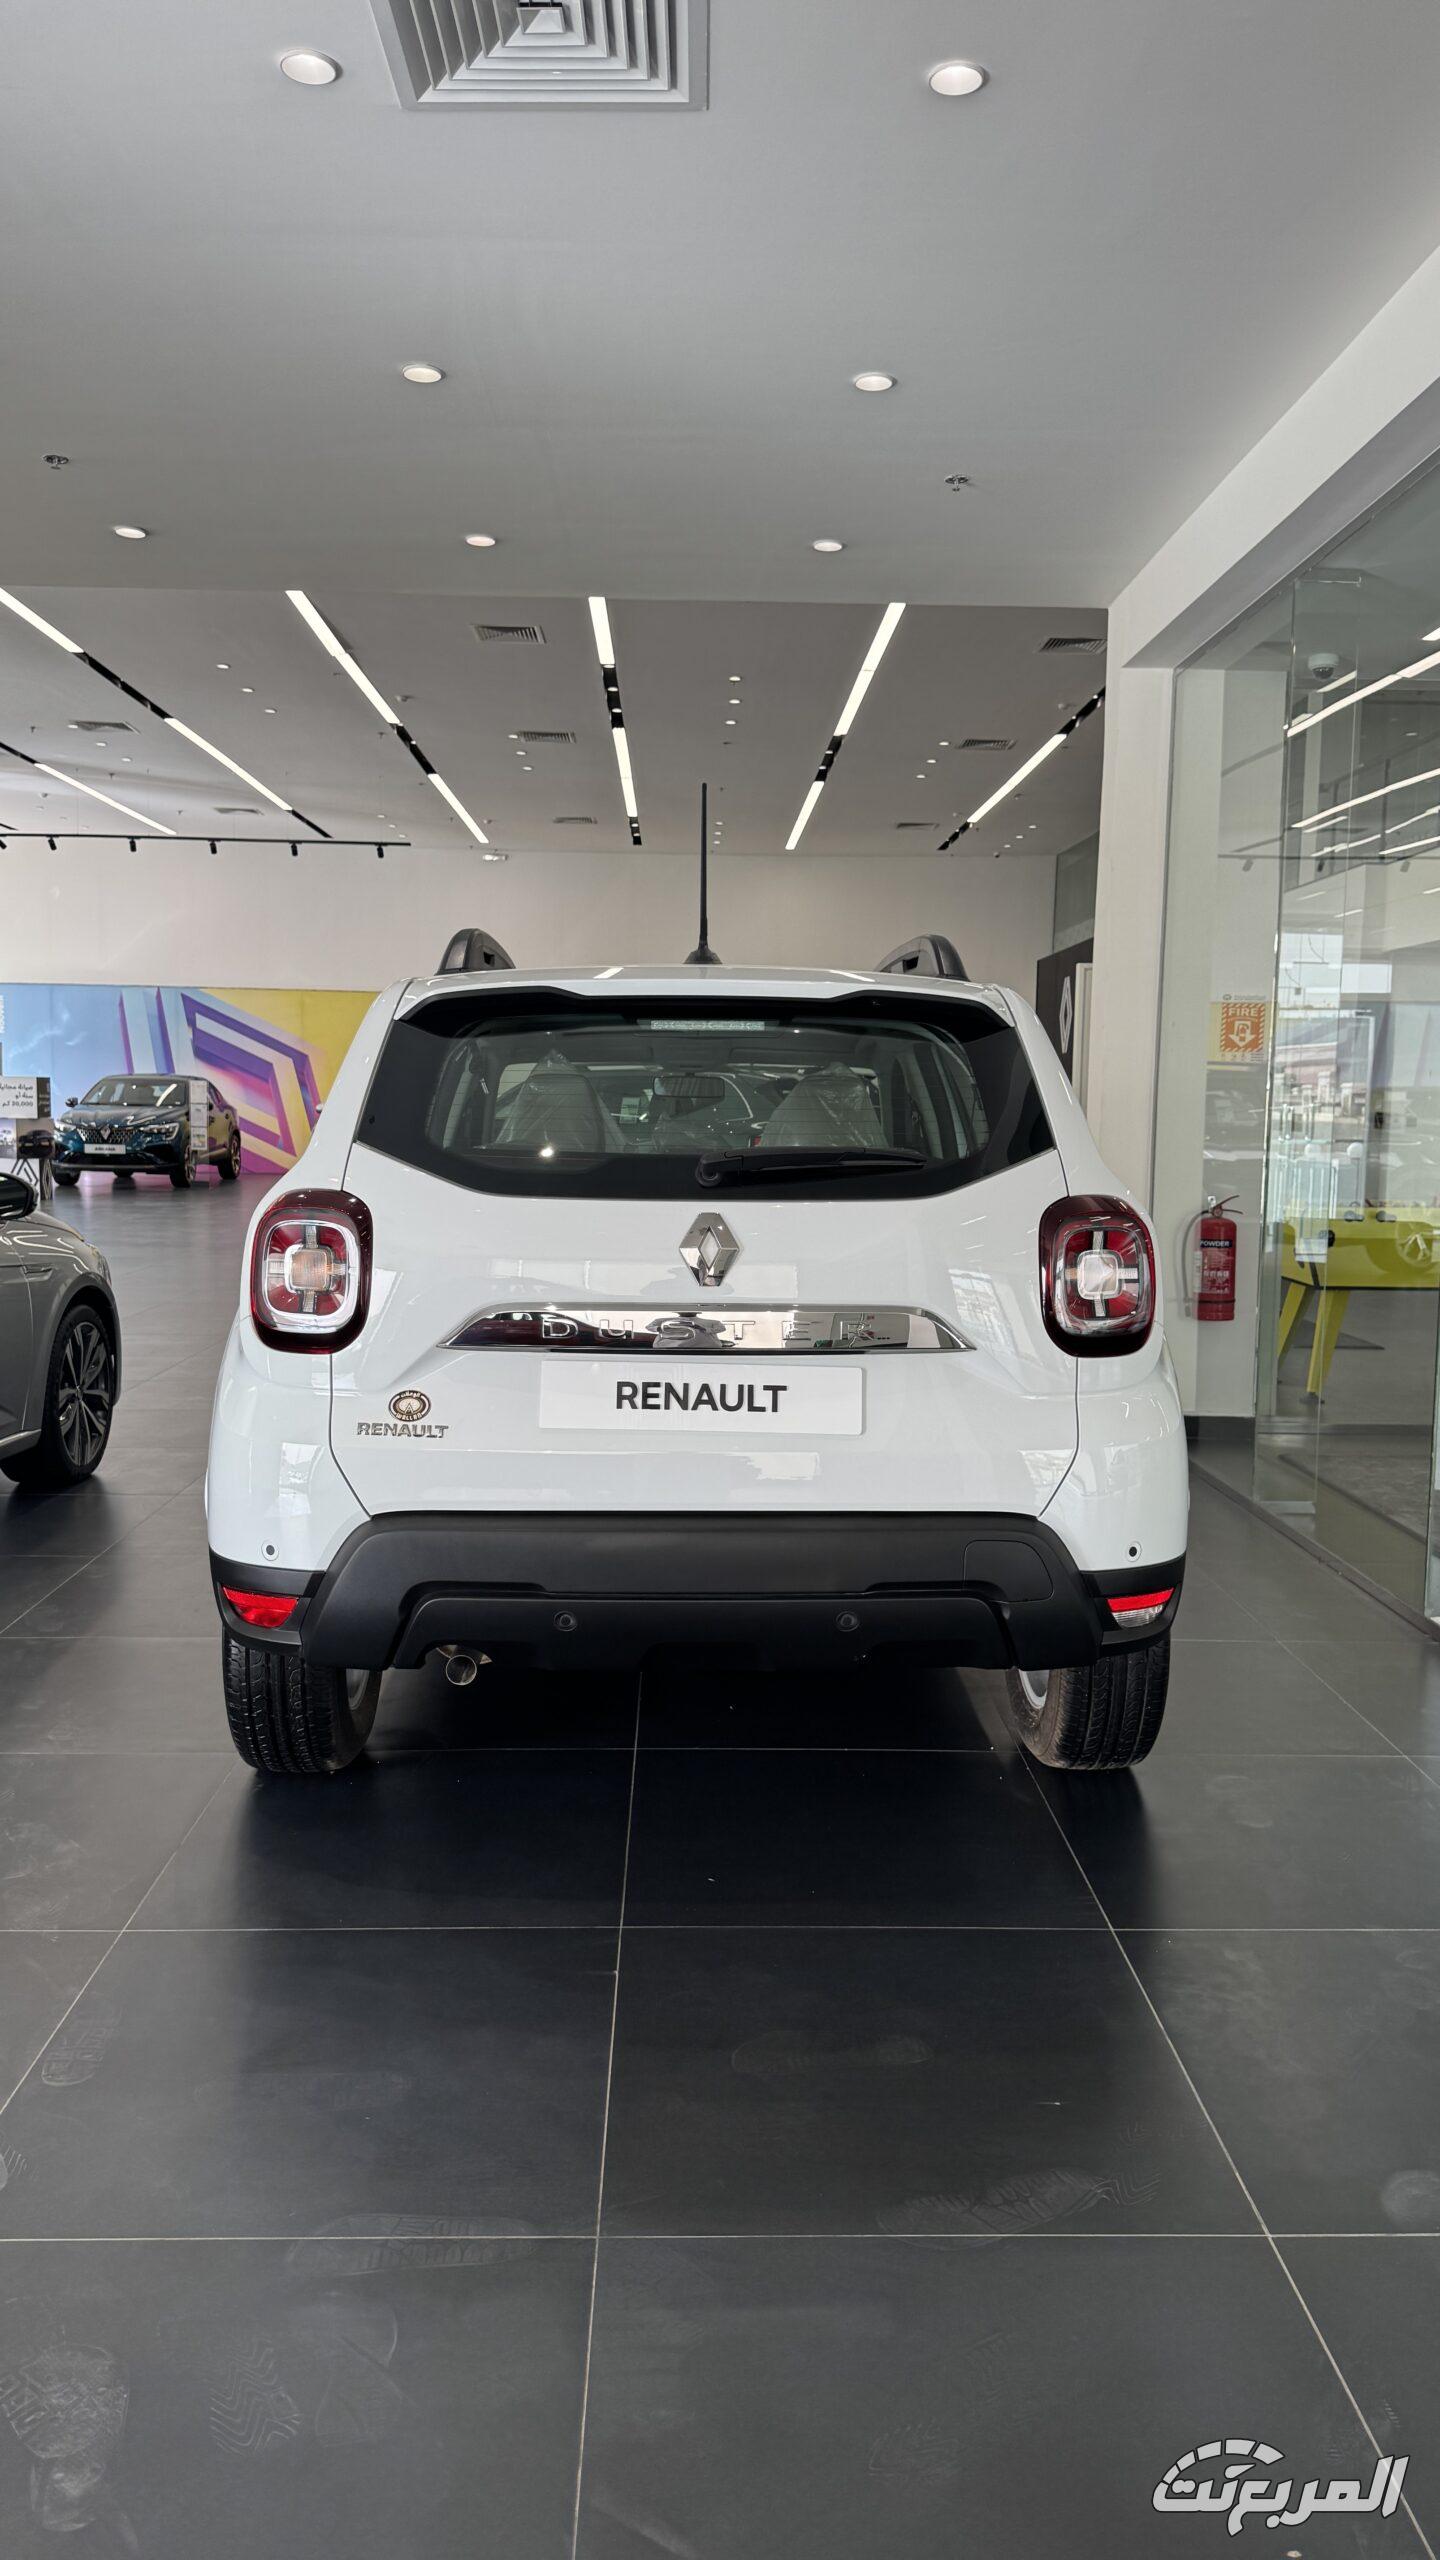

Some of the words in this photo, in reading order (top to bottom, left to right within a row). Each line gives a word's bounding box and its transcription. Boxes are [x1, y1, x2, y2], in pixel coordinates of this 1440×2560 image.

[1228, 1007, 1259, 1017] FIRE
[542, 1317, 874, 1341] DUSTER
[615, 1380, 788, 1413] RENAULT
[357, 1422, 449, 1439] RENAULT
